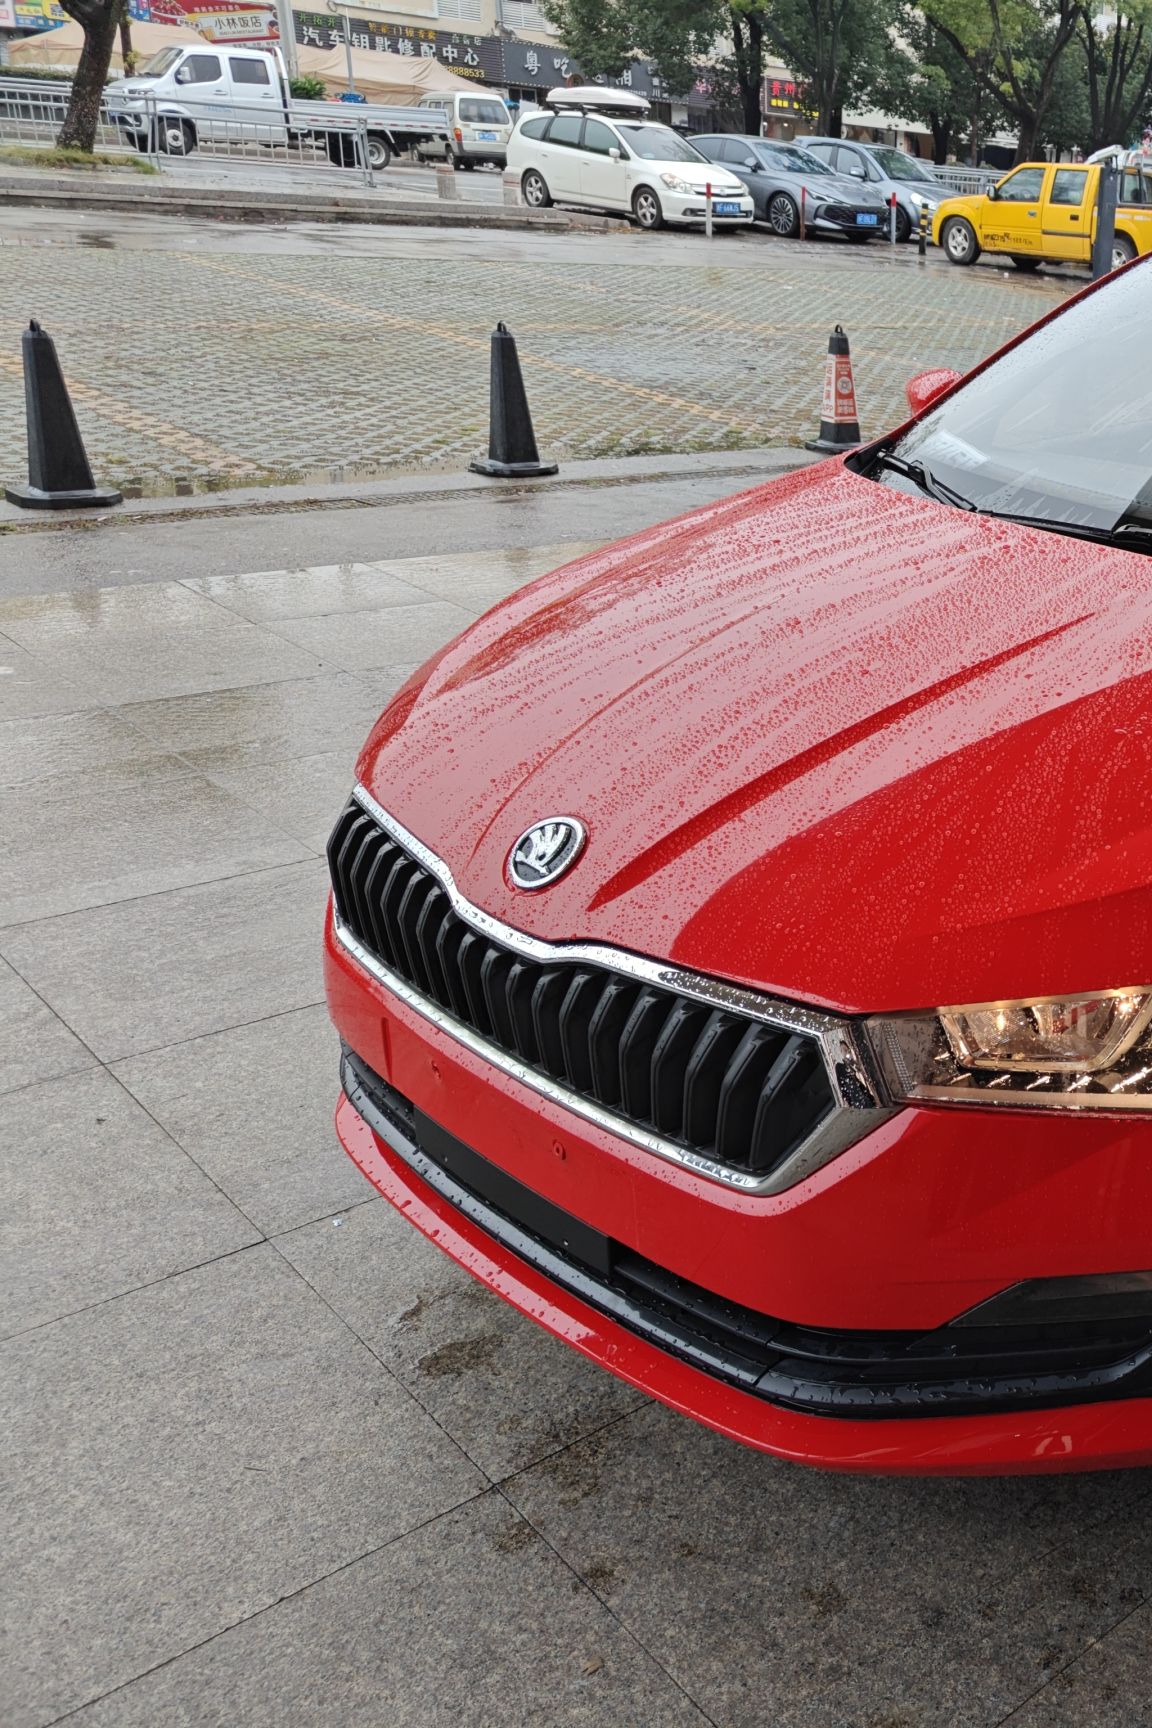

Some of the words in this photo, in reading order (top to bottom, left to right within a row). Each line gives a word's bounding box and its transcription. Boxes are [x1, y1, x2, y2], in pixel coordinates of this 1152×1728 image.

[214, 15, 262, 30] 小林饭店
[302, 25, 480, 66] 汽车钥匙修配中心
